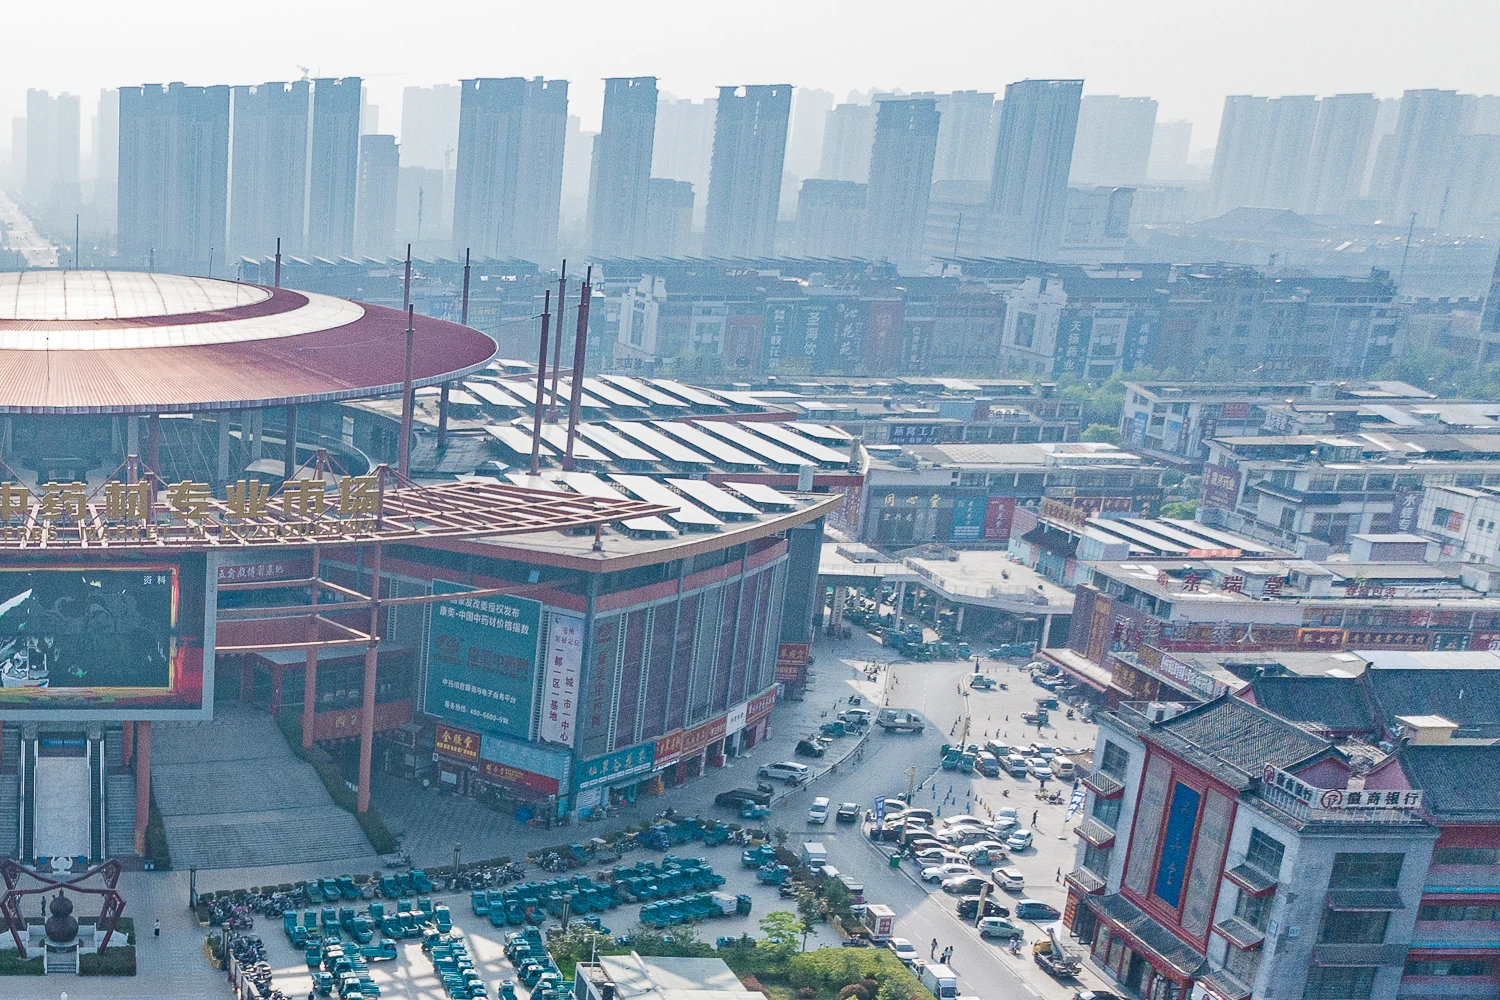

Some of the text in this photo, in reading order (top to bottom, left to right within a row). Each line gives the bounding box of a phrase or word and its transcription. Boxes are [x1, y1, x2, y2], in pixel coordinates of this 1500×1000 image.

[80, 523, 170, 541] MARKET
[184, 522, 207, 540] IN
[1347, 792, 1419, 806] 徽商银行
